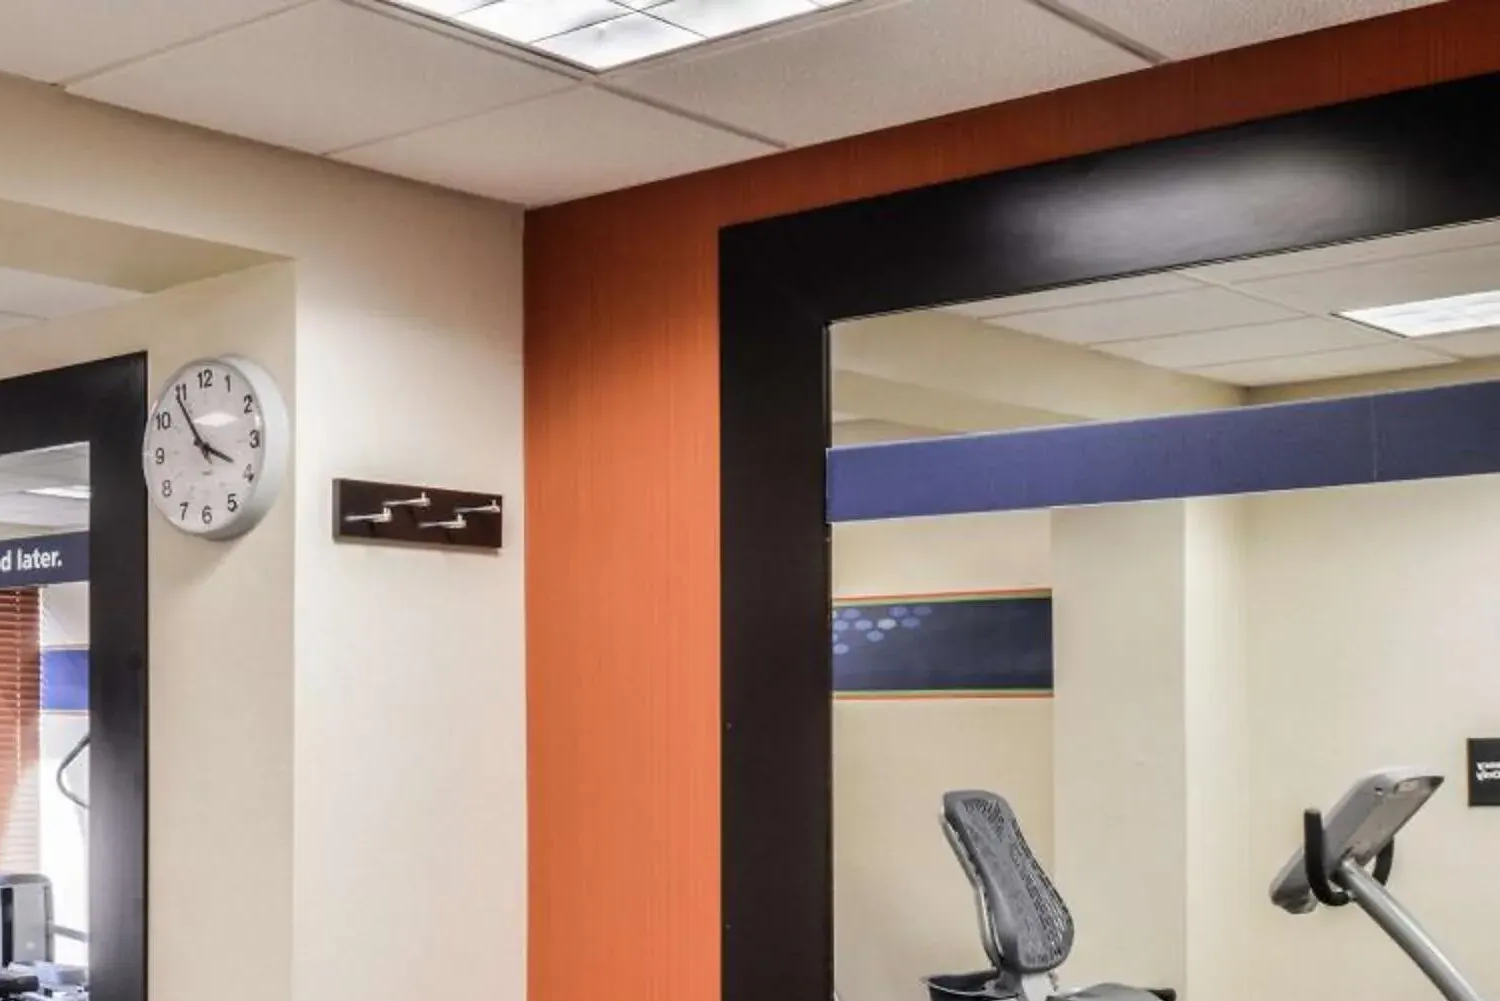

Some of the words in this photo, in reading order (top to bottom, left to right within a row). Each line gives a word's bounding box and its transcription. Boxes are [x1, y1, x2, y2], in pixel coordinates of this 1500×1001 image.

[197, 369, 213, 389] 12
[224, 374, 232, 393] 1
[175, 383, 187, 401] 11
[243, 394, 253, 414] 2
[156, 411, 171, 430] 10
[250, 429, 260, 448] 3
[155, 447, 165, 464] 9
[243, 464, 254, 482] 4
[161, 479, 172, 497] 8
[179, 502, 189, 520] 7
[227, 493, 238, 512] 5
[201, 505, 213, 524] 6
[16, 548, 62, 570] later.
